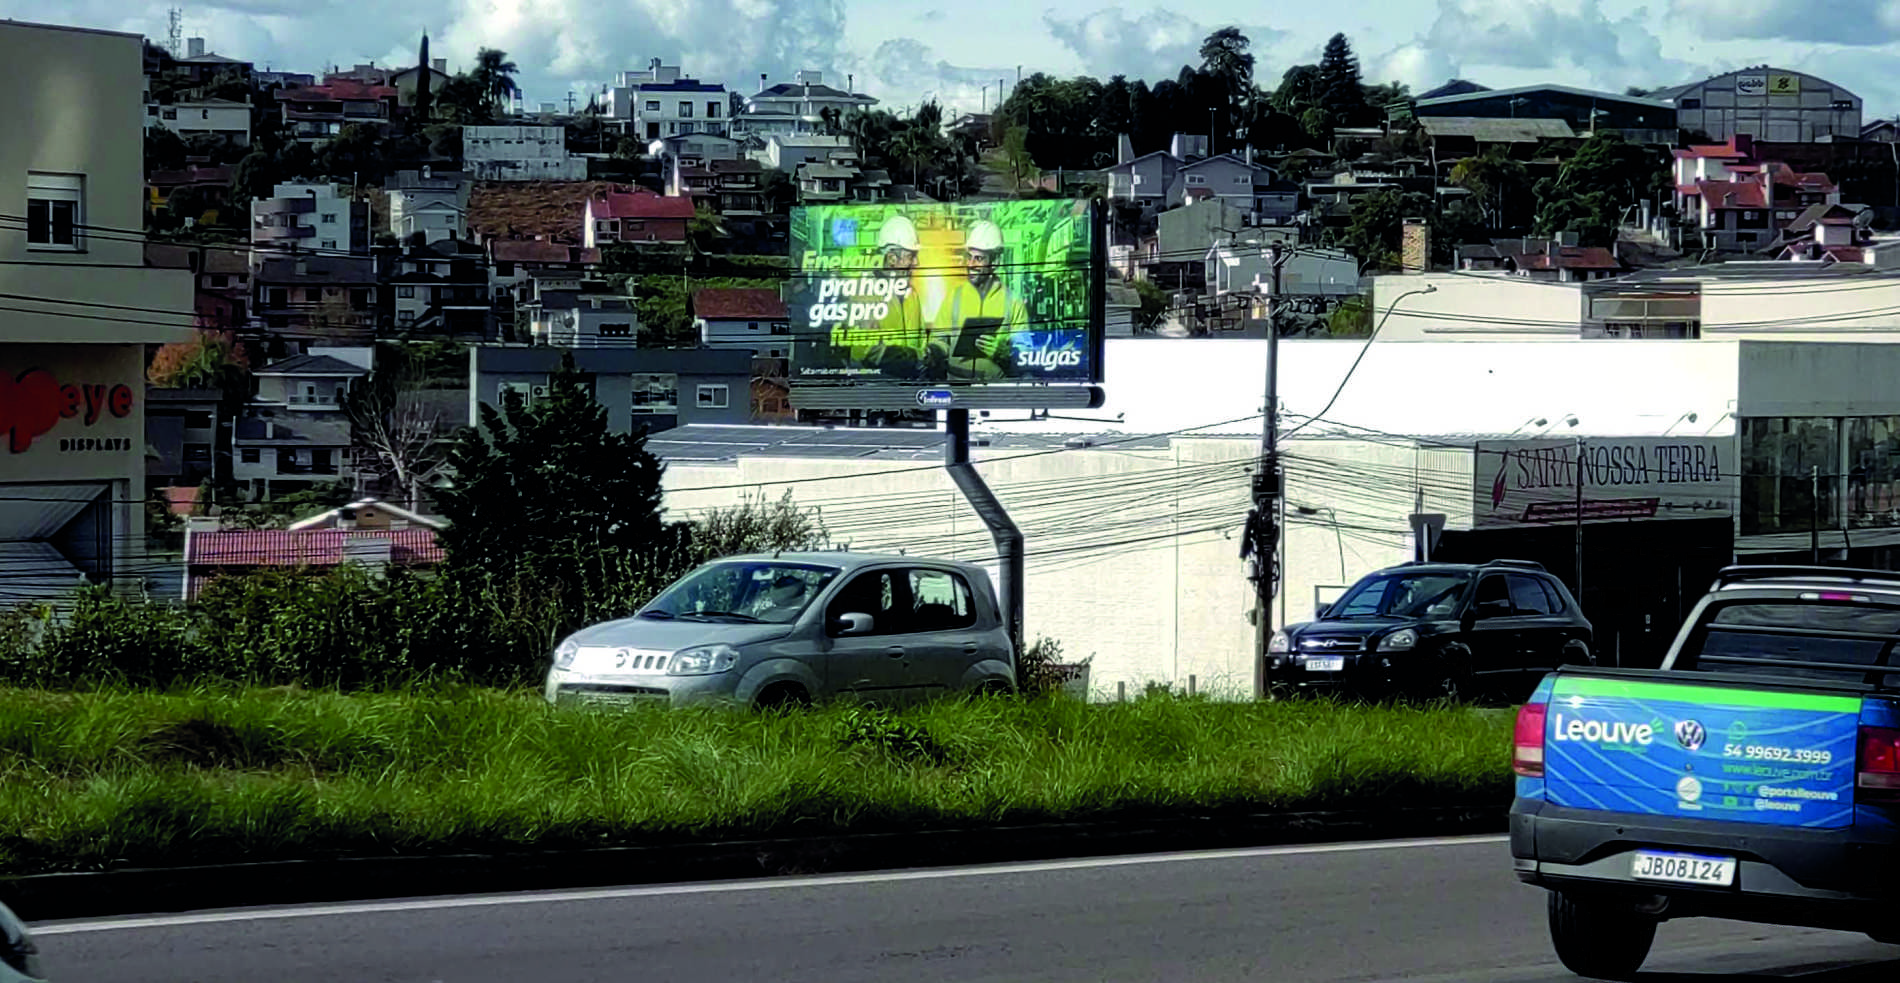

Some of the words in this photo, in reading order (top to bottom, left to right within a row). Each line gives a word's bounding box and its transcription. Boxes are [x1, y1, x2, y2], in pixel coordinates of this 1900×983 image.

[818, 278, 858, 303] pra
[859, 272, 912, 302] hoje,
[809, 297, 848, 328] gás
[848, 302, 889, 327] pro
[0, 367, 133, 454] peye
[60, 438, 131, 452] DISPLAYS
[1518, 447, 1573, 489] SARA
[1580, 445, 1649, 486] NOSSA
[1655, 444, 1721, 484] TERRA
[1555, 713, 1653, 745] Leouve
[1723, 743, 1742, 757] 54
